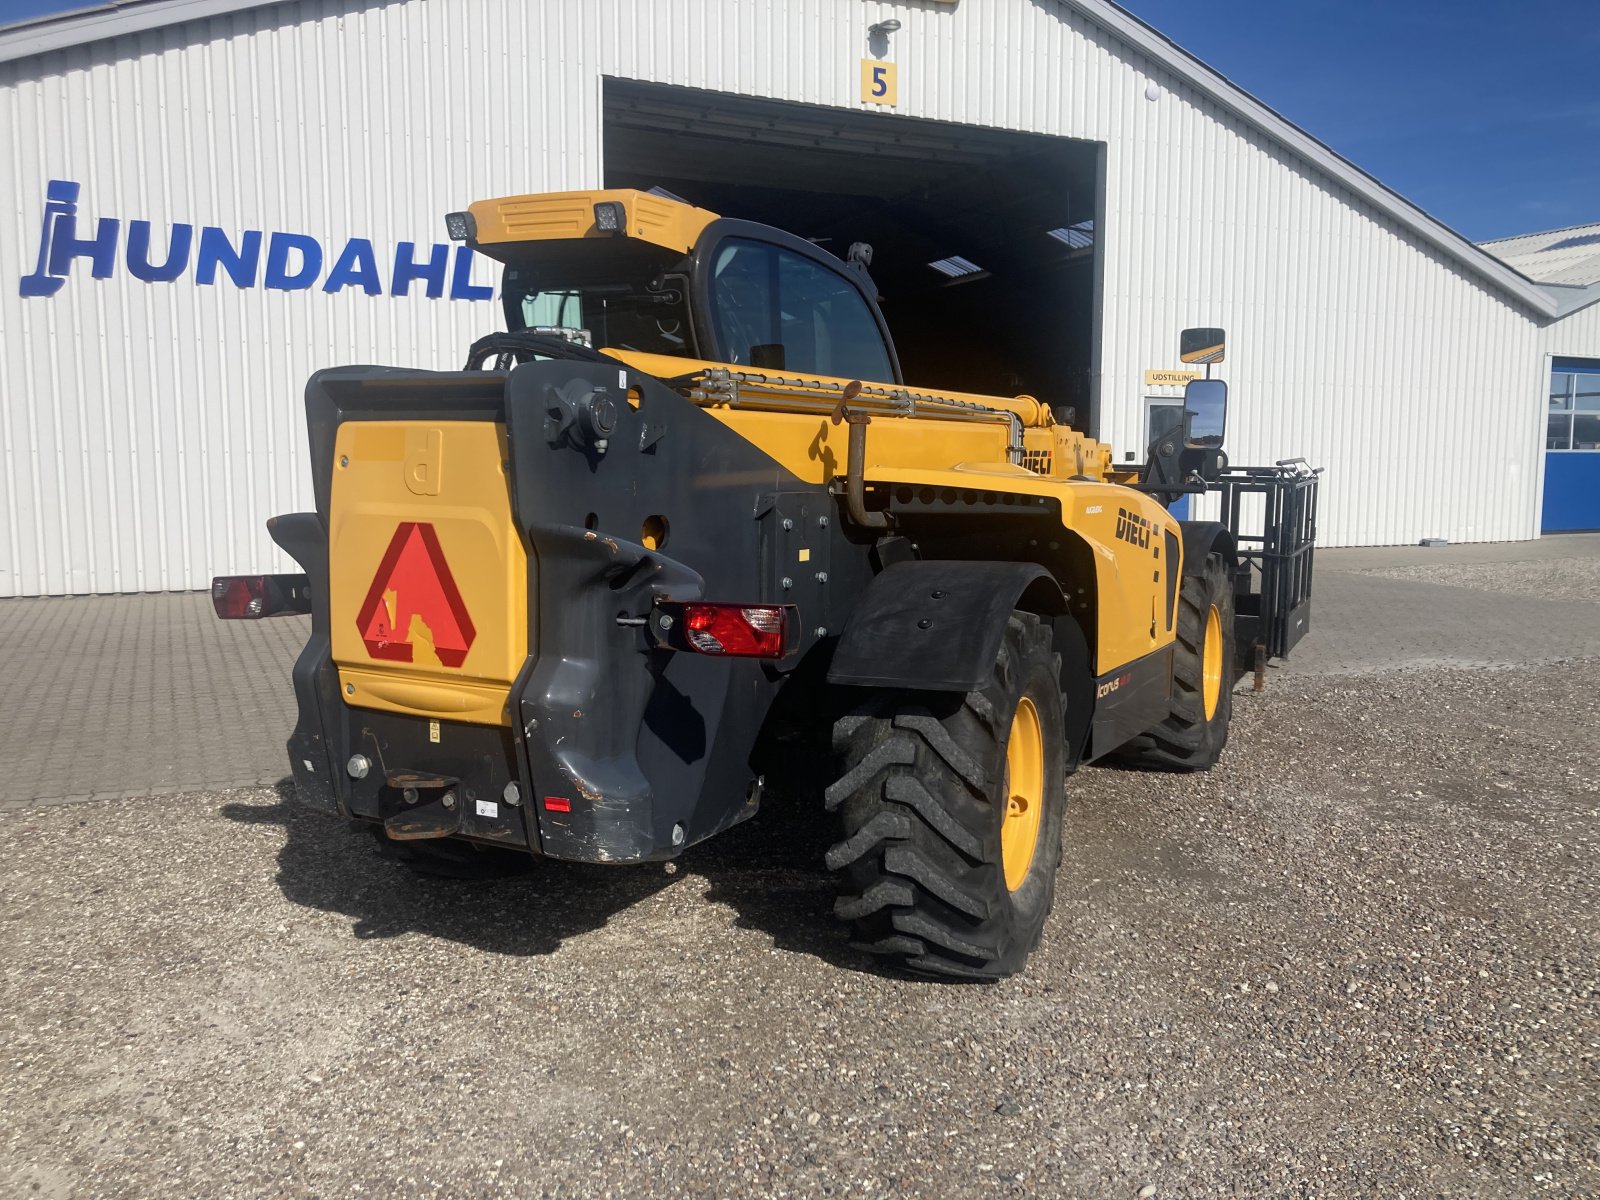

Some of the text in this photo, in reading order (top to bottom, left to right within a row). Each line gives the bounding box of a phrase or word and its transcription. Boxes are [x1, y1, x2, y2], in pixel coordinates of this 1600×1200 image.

[872, 67, 887, 97] 5
[1152, 373, 1194, 382] UDSTILLING
[1115, 507, 1151, 550] DIECI
